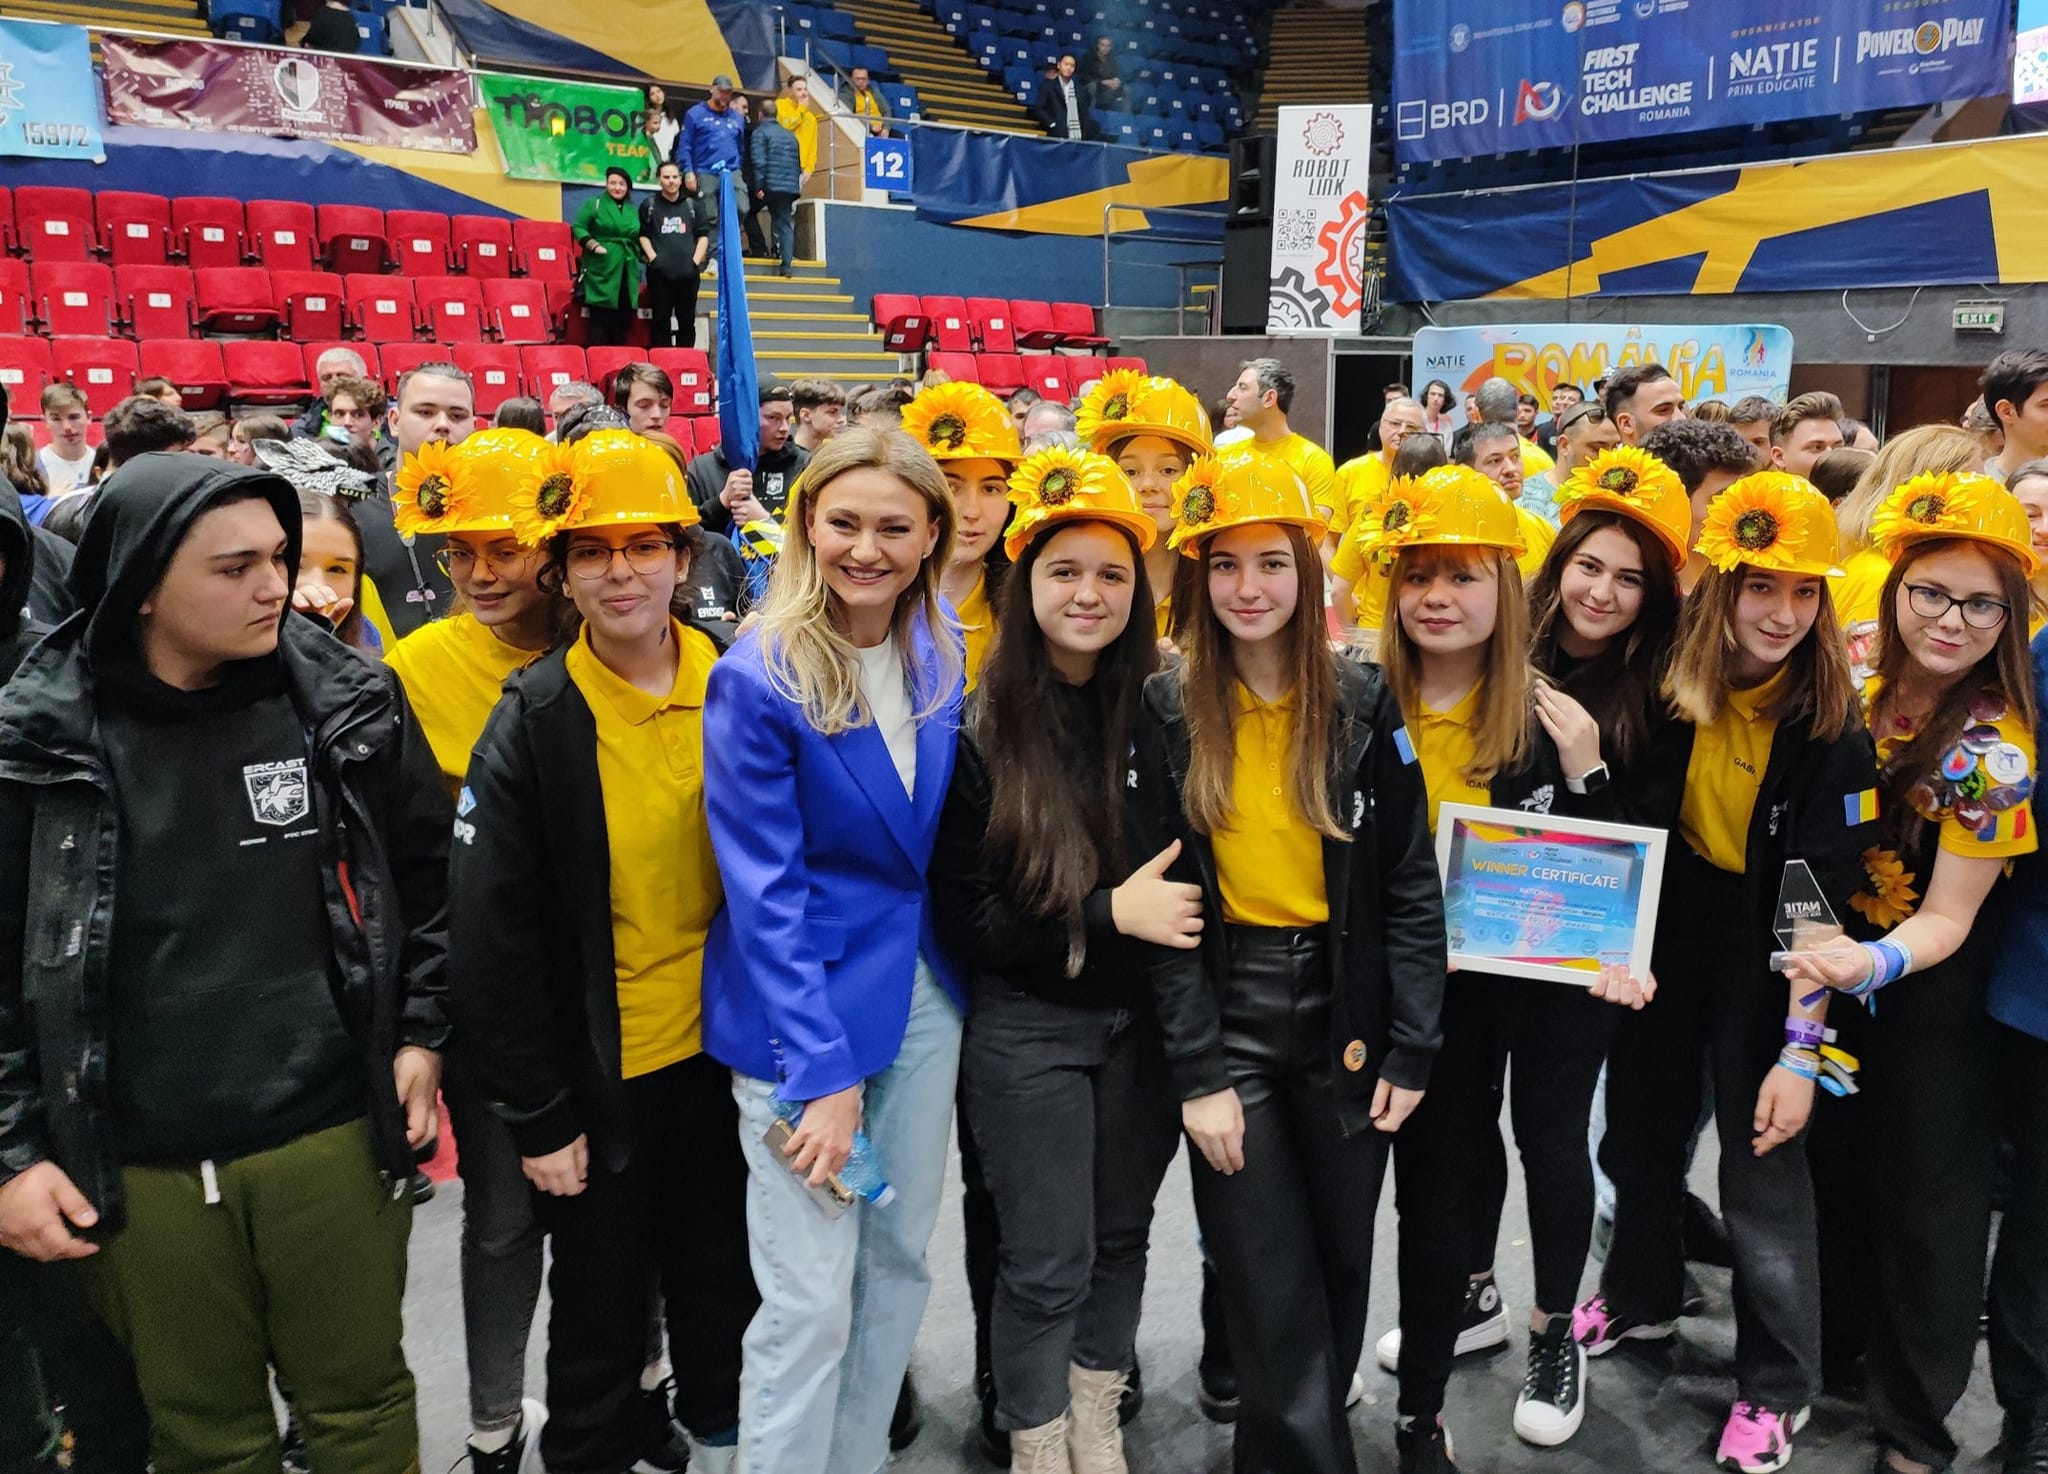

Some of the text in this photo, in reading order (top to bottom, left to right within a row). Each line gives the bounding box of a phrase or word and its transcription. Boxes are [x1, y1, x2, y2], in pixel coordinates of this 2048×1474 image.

[1583, 43, 1640, 71] FIRST
[1582, 68, 1632, 93] TECH
[1581, 81, 1693, 116] CHALLENGE
[1727, 84, 1753, 98] PRIN
[1430, 98, 1489, 129] BRD
[1639, 106, 1691, 122] ROMANIA
[870, 151, 904, 178] 12
[1293, 159, 1351, 178] ROBOT
[1308, 178, 1345, 196] LINK
[1961, 313, 1991, 324] EXIT
[1729, 368, 1777, 378] ROMANIA
[243, 758, 306, 774] ERCAST
[1471, 858, 1620, 889] WINNER CERTIFICATE
